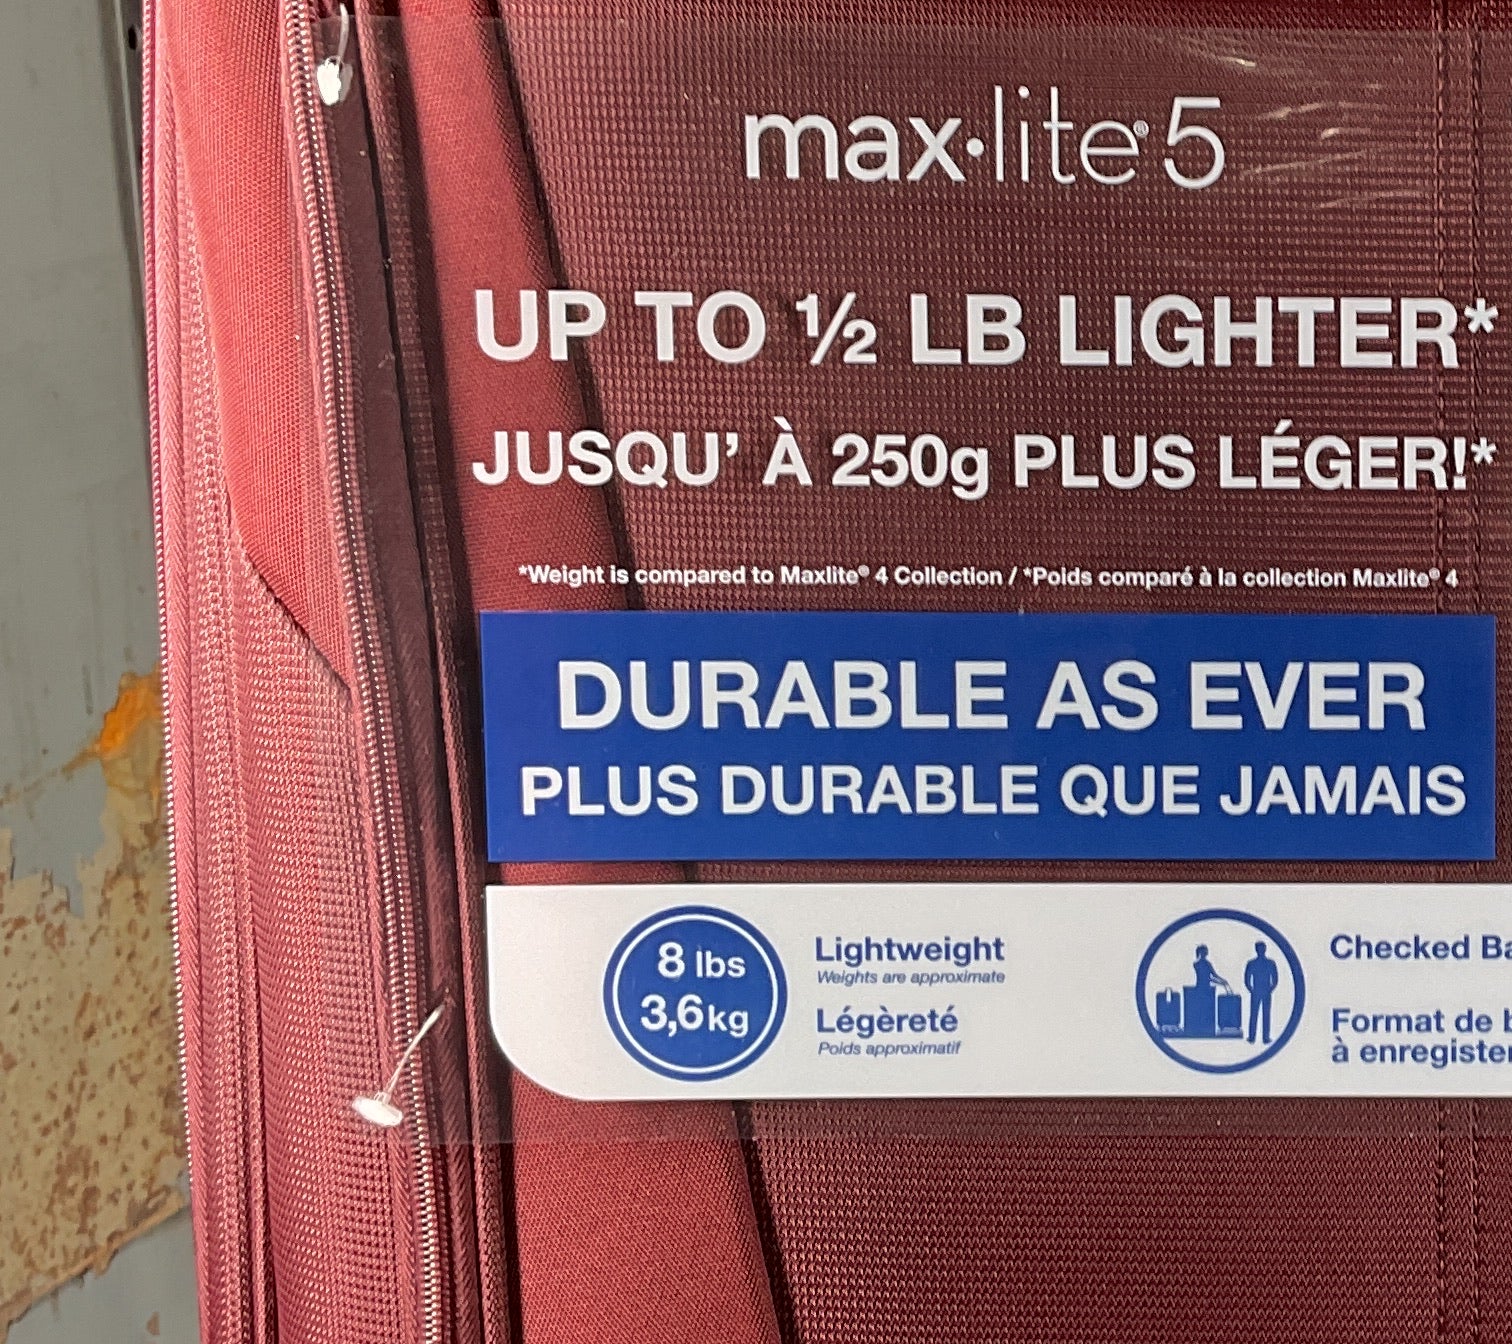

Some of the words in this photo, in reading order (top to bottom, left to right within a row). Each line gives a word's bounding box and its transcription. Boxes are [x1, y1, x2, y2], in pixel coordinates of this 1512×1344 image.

[1165, 97, 1224, 188] 5
[475, 290, 606, 361] UP
[635, 291, 765, 363] TO
[911, 294, 1025, 364] LB
[763, 417, 812, 485] À
[832, 434, 988, 499] 250g
[1015, 435, 1195, 489] PLUS
[611, 565, 628, 583] is
[635, 566, 745, 587] compared
[751, 567, 773, 584] to
[875, 566, 888, 584] 4
[895, 566, 1002, 585] Collection
[1009, 567, 1017, 585] /
[1099, 566, 1193, 590] comparé
[1200, 566, 1212, 586] à
[1219, 568, 1236, 586] la
[1243, 568, 1346, 586] collection
[1446, 569, 1458, 587] 4
[559, 661, 1007, 729] DURABLE
[1037, 661, 1157, 730] AS
[1191, 662, 1425, 729] EVER
[522, 765, 698, 815] PLUS
[722, 766, 1038, 814] DURABLE
[1061, 765, 1199, 817] QUE
[1220, 766, 1465, 815] JAMAIS
[658, 942, 685, 978] 8
[697, 951, 745, 977] lbs
[816, 936, 1004, 967] Lightweight
[1331, 935, 1469, 960] Checked
[818, 970, 877, 987] Weights
[883, 973, 906, 984] are
[911, 970, 1005, 986] approximate
[817, 1005, 958, 1039] Légèreté
[1333, 1009, 1444, 1032] Format
[1455, 1009, 1492, 1033] de
[818, 1042, 861, 1055] Poids
[866, 1041, 961, 1057] approximatif
[1332, 1036, 1348, 1063] à
